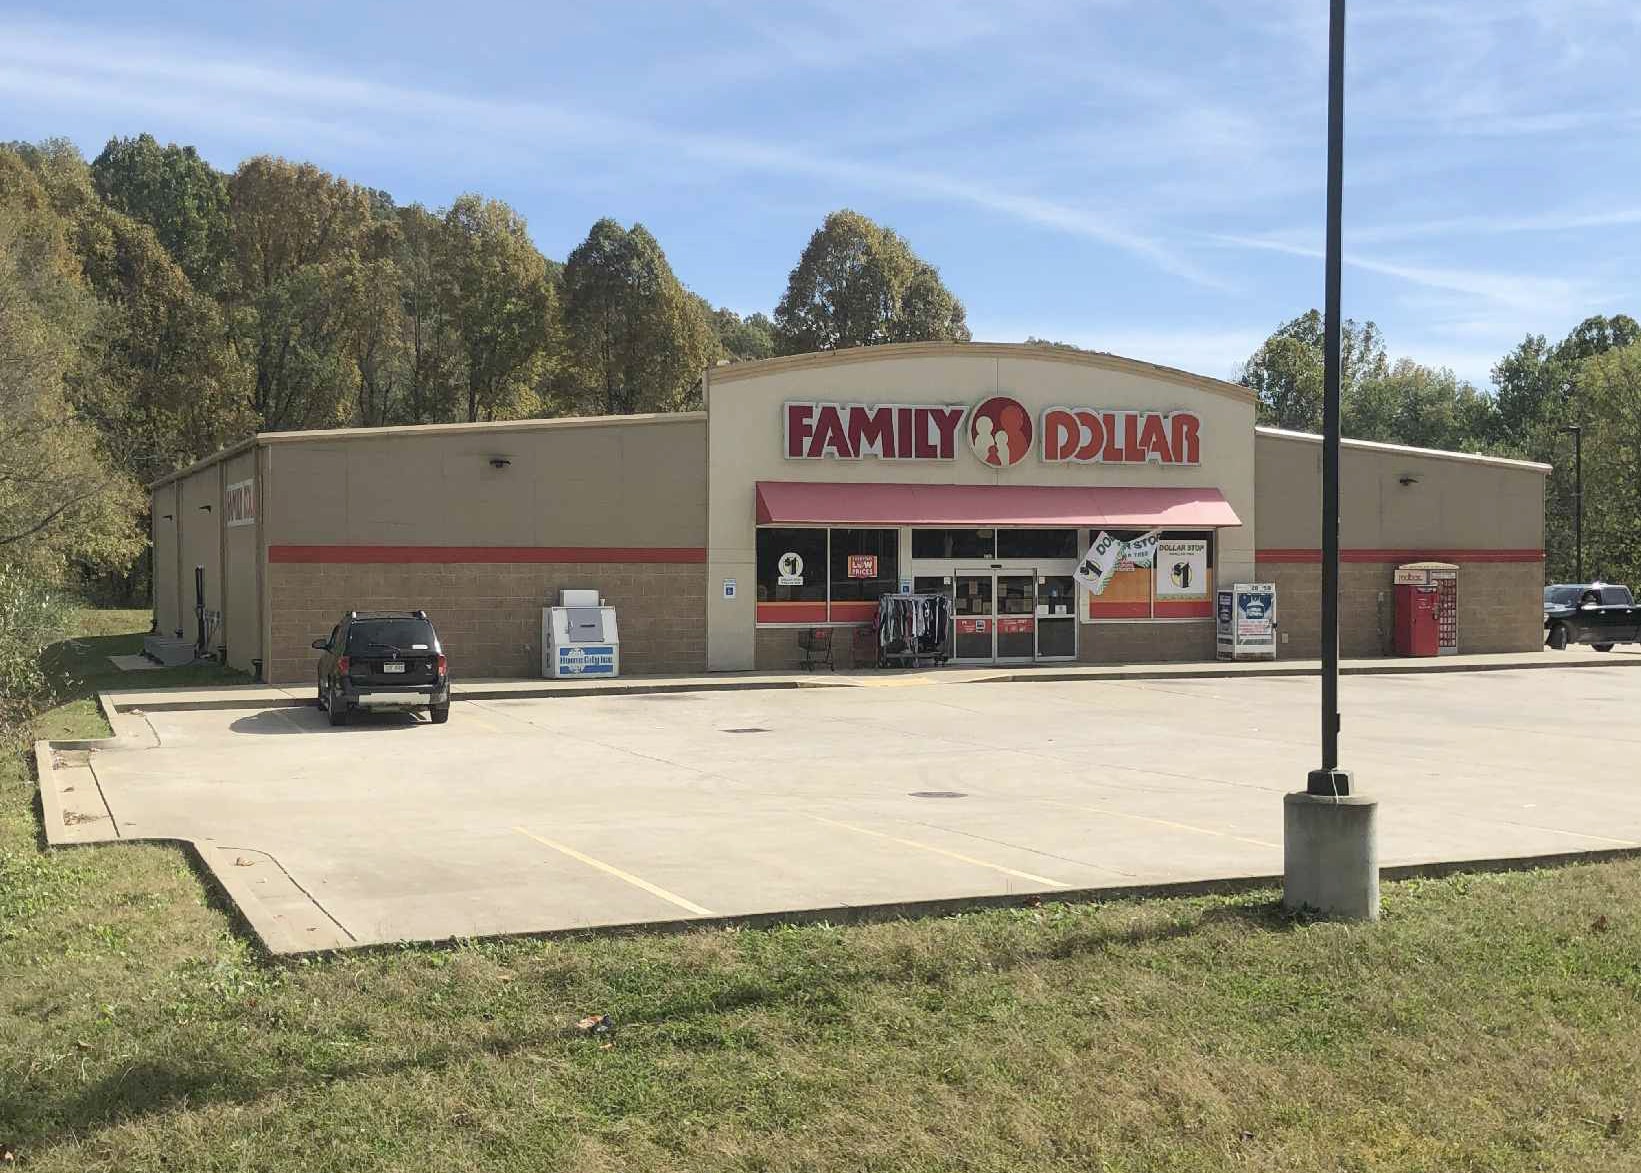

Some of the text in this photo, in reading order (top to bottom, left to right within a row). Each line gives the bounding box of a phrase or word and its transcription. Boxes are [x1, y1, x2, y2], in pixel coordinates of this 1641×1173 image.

[784, 402, 1201, 466] FAMILY DOLLAR
[1159, 544, 1205, 552] DOLLAR STOP
[852, 561, 873, 569] LOW
[852, 569, 873, 577] PRICES
